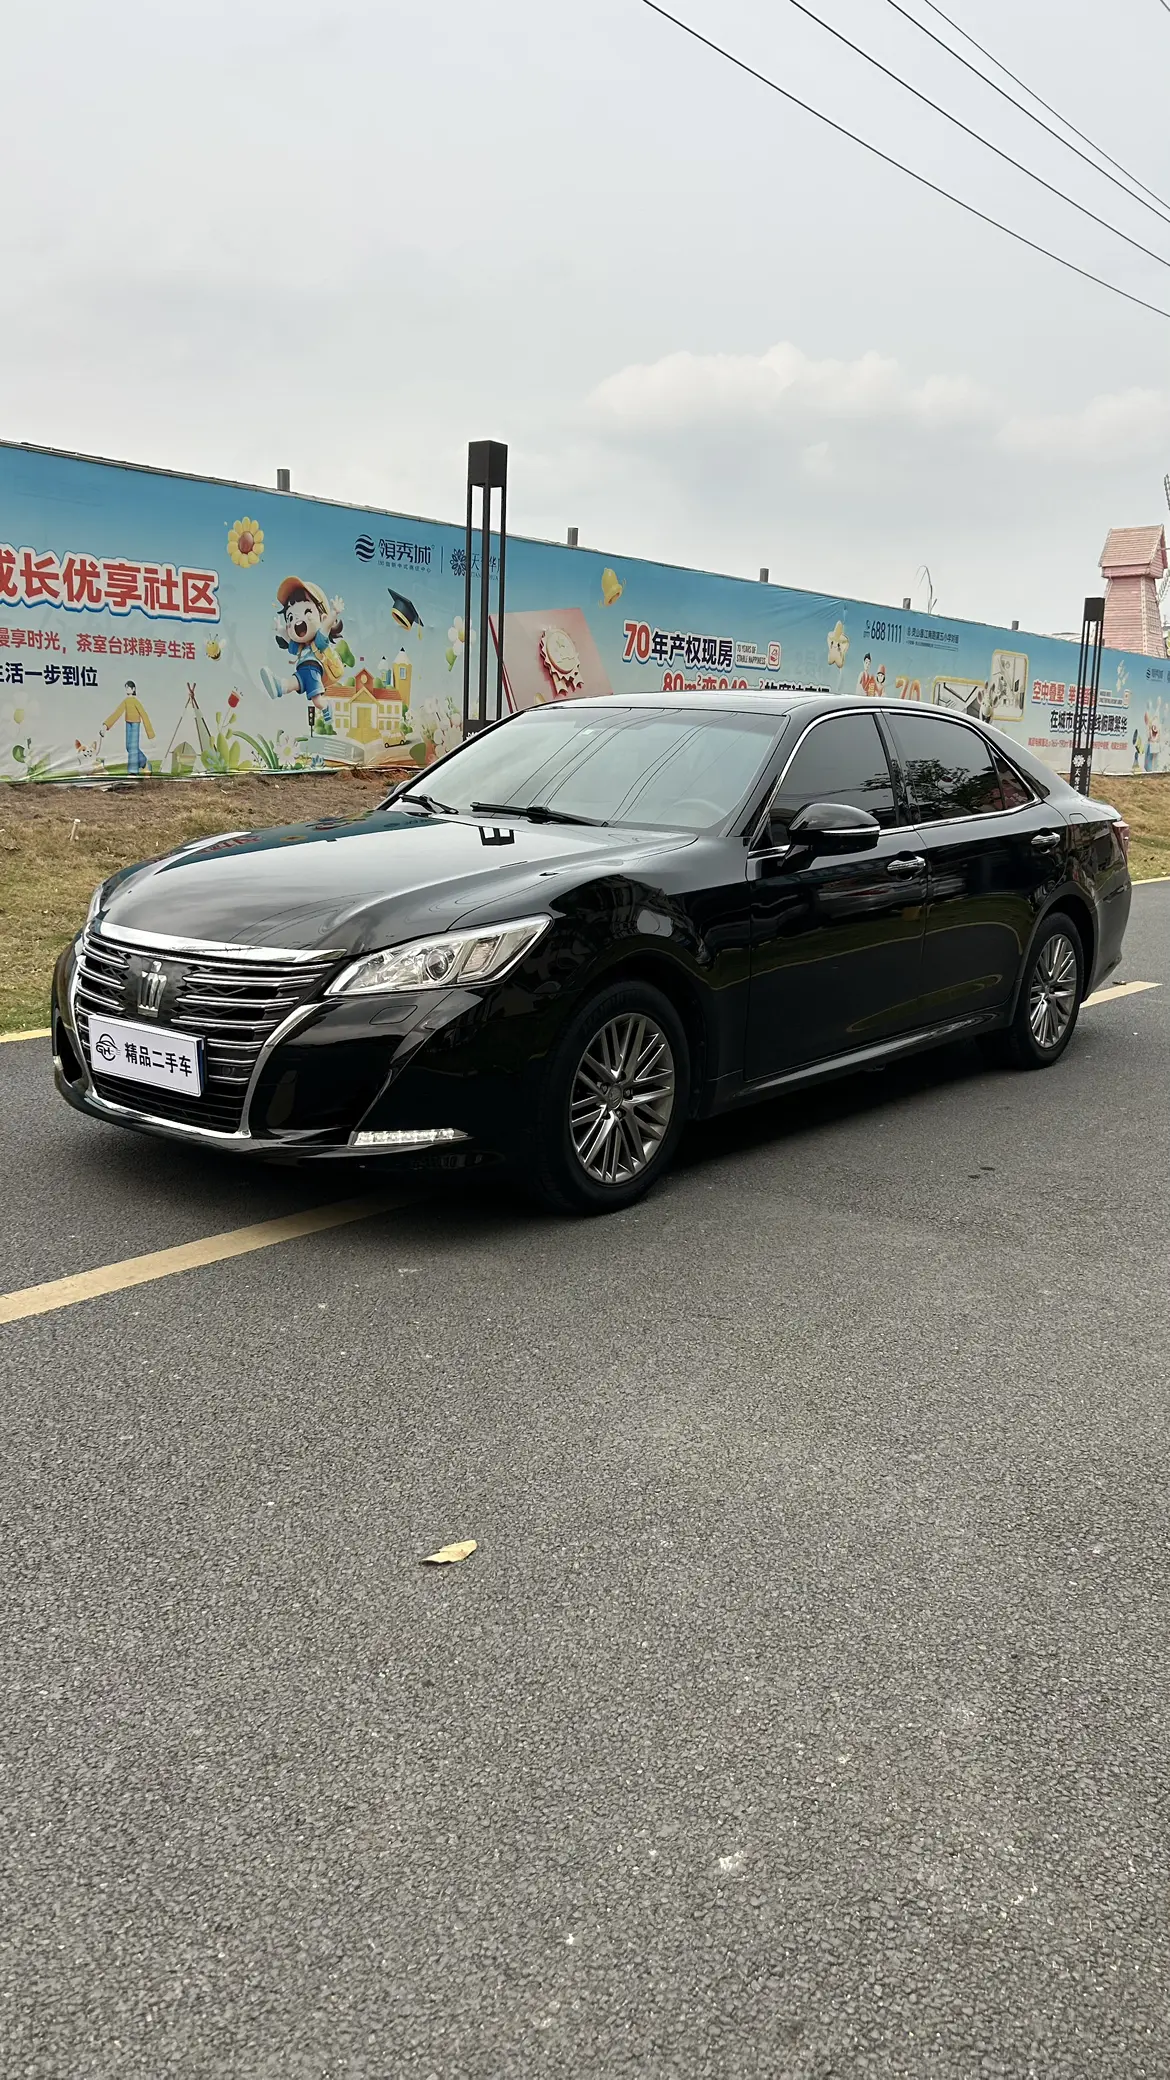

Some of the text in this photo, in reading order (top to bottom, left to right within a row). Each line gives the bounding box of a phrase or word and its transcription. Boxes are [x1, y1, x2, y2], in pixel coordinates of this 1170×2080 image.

[624, 622, 733, 668] 70年产权现房
[0, 662, 98, 686] 活一步到位
[124, 1041, 192, 1077] 精品二手车
